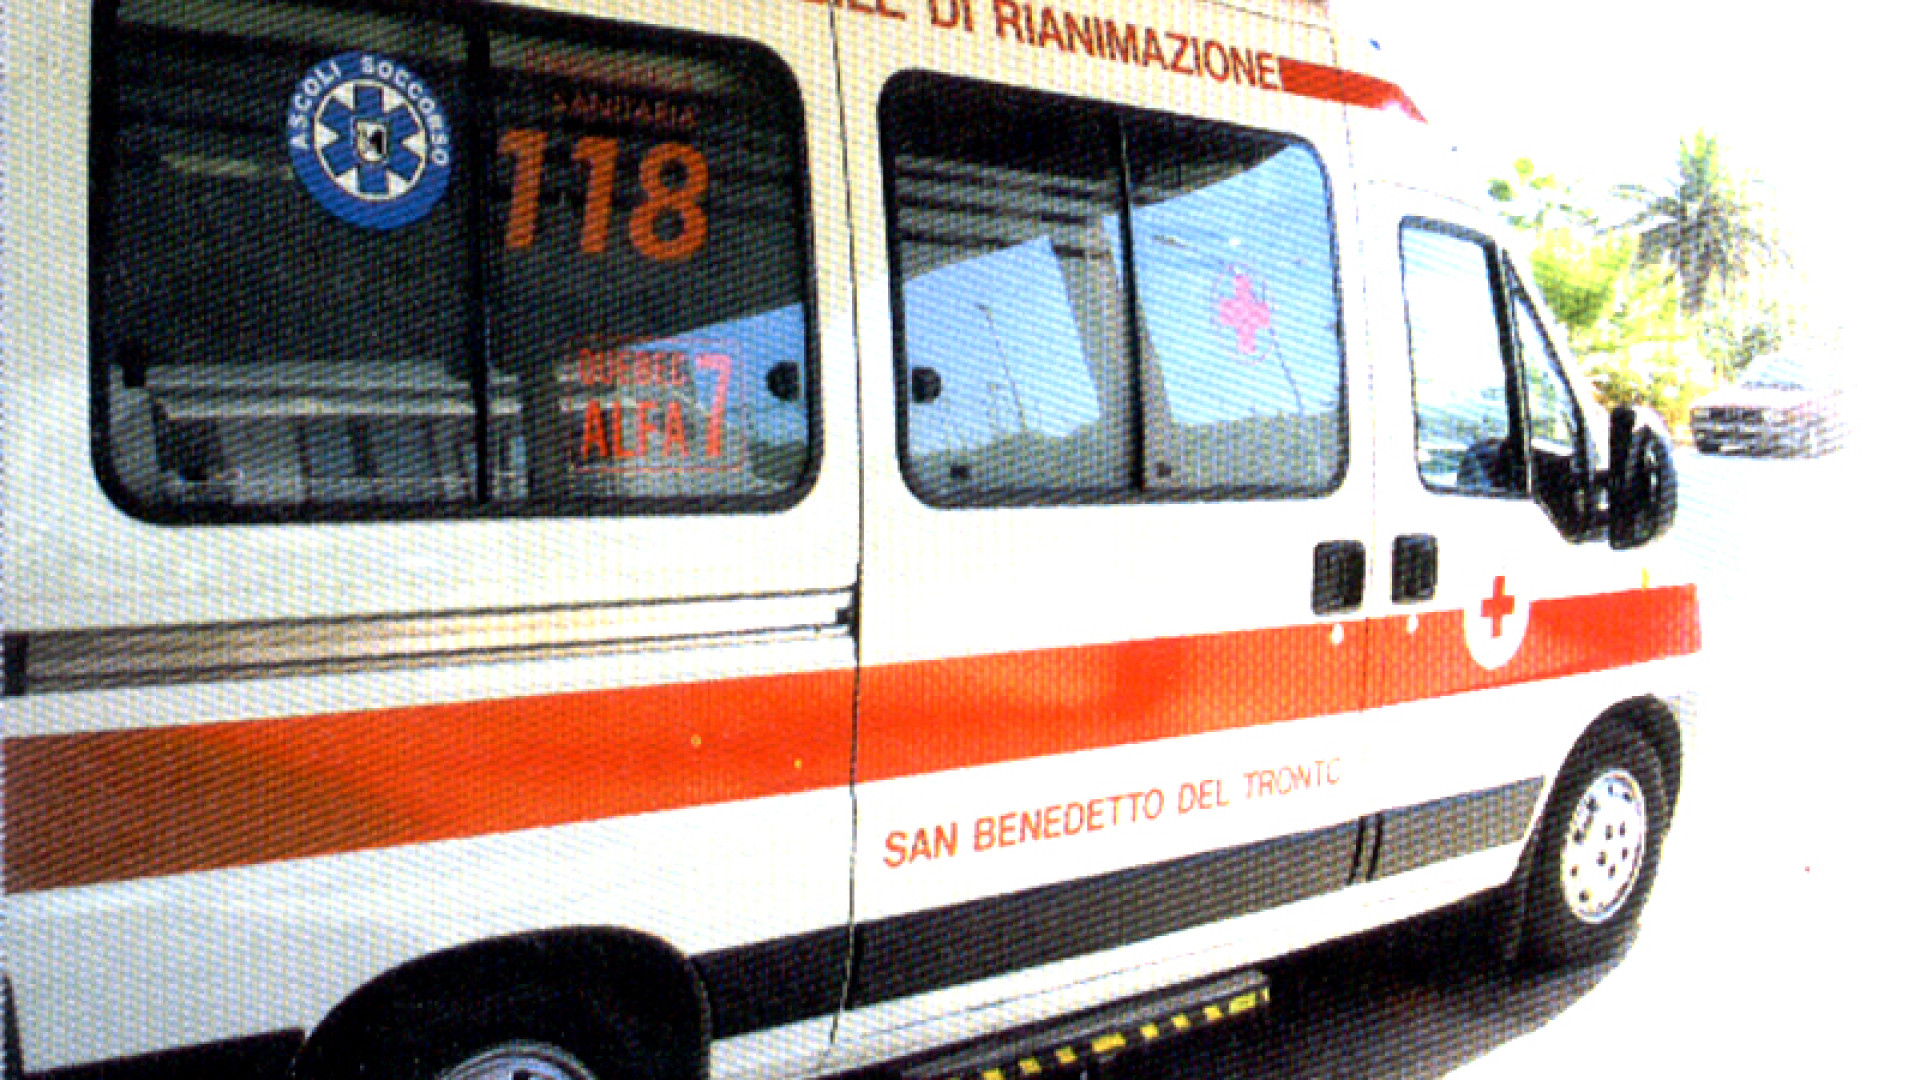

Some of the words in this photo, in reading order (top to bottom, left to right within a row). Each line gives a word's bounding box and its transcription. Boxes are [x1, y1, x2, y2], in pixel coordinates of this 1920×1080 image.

[993, 0, 1280, 90] RIANIMAZIONE
[289, 59, 342, 150] ASCOLI
[361, 54, 450, 167] SOCCORSO
[499, 128, 709, 261] 118
[581, 400, 690, 459] ALFA
[695, 352, 733, 458] 7
[883, 820, 958, 869] SAN
[973, 788, 1165, 852] BENEDETTO
[1177, 777, 1230, 814] DEL
